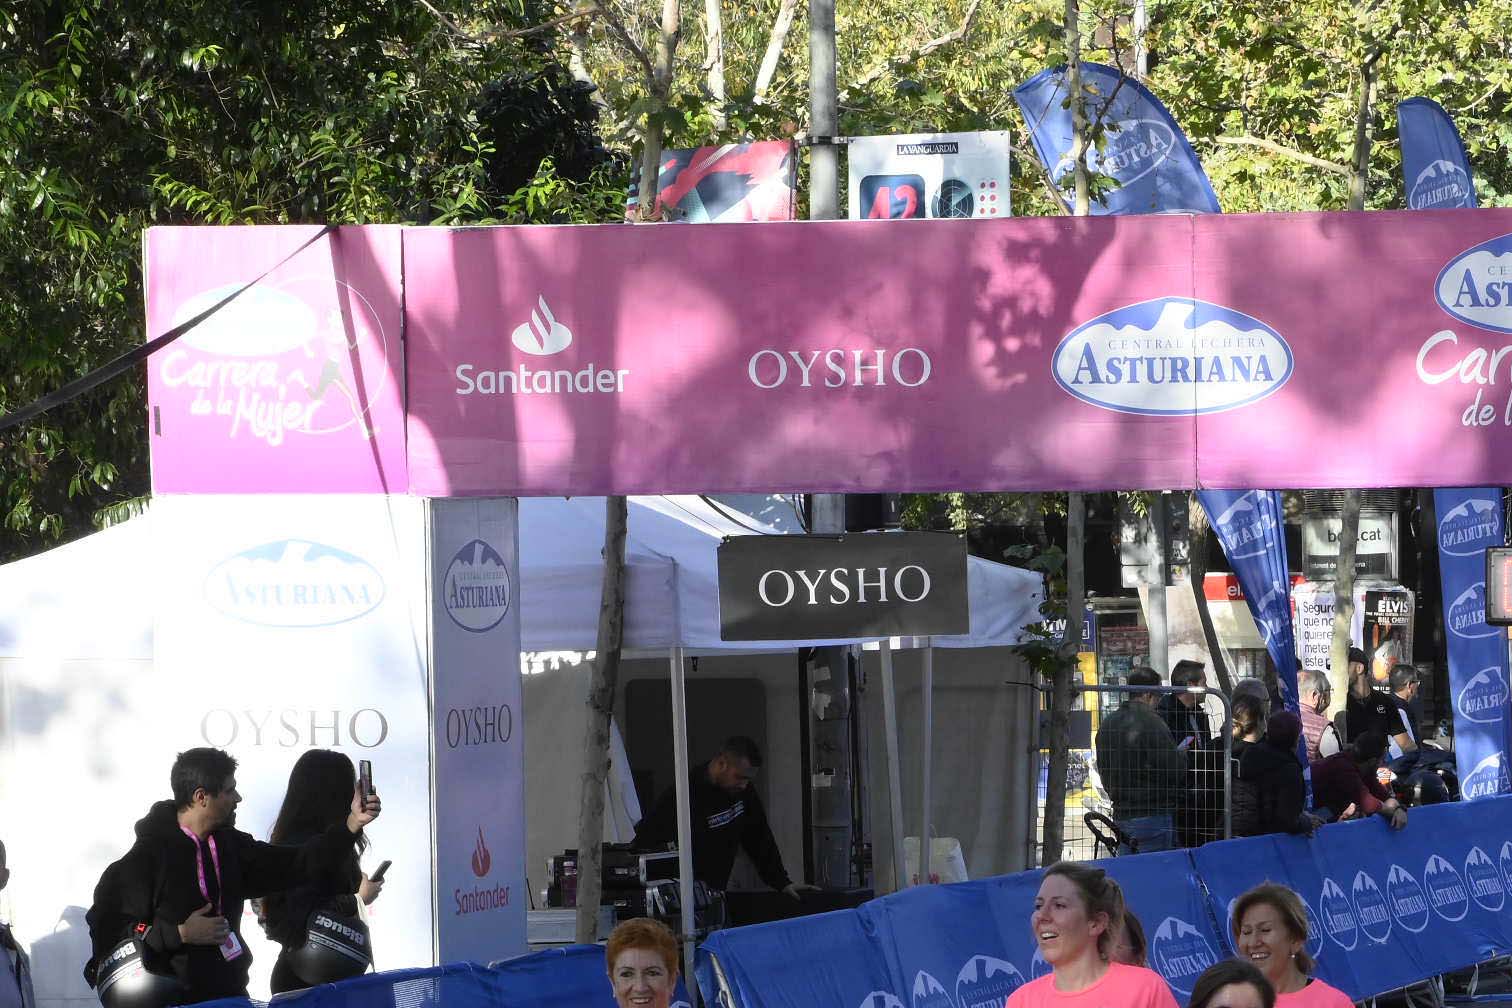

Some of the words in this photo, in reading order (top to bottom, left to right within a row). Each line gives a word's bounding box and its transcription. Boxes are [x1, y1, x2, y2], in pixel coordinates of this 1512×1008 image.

[1107, 336, 1184, 350] CENTRAL
[1190, 335, 1266, 350] LECHERA
[160, 349, 284, 388] Carrera
[455, 362, 630, 396] Santander
[748, 347, 932, 390] OYSHO
[1071, 341, 1274, 386] ASTURIANA
[1462, 388, 1496, 427] de
[449, 573, 507, 610] ASTURIANA
[758, 564, 931, 607] OYSHO
[1303, 617, 1320, 628] que
[1377, 600, 1409, 614] ELVIS
[200, 707, 389, 749] OYSHO
[446, 703, 513, 750] OYSHO
[455, 880, 510, 917] Santander
